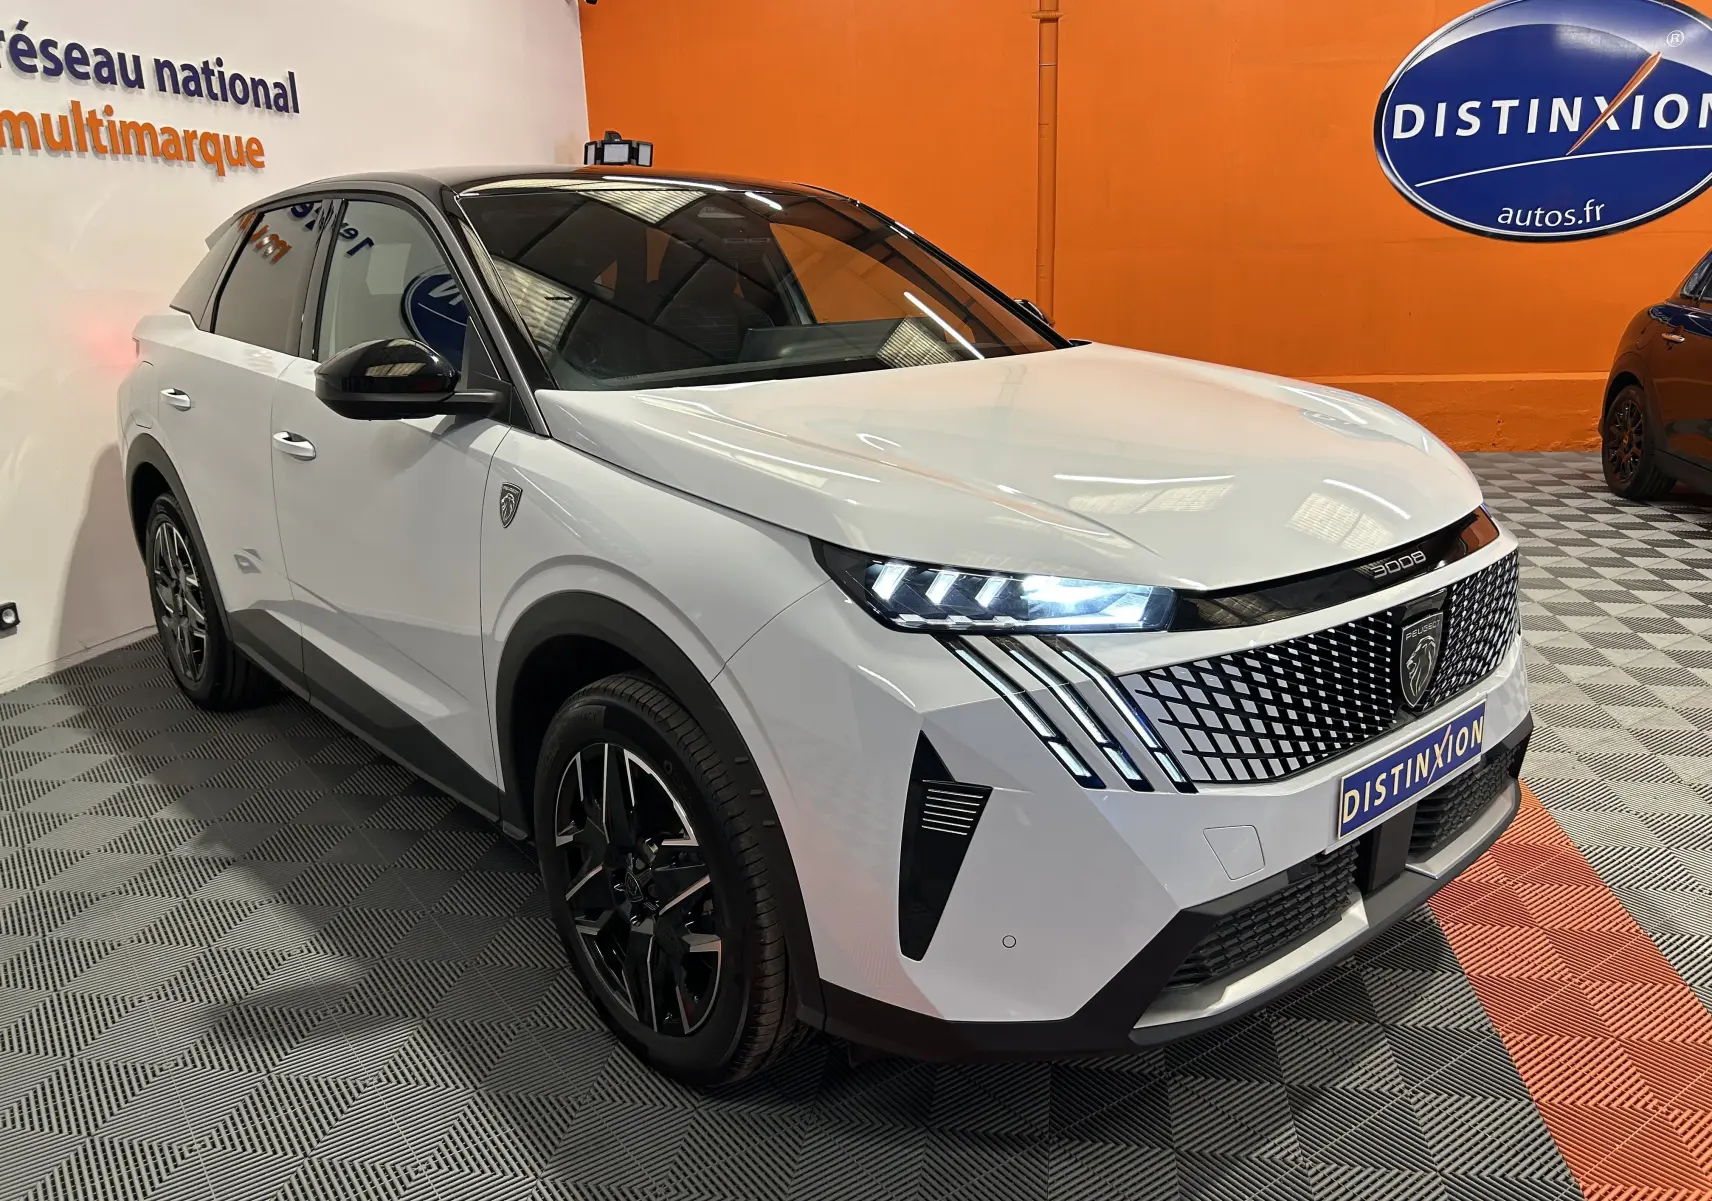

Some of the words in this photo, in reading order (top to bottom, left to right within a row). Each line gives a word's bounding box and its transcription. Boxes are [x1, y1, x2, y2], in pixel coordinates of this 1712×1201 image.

[154, 57, 300, 114] national
[0, 100, 266, 177] multimarque
[1497, 199, 1605, 227] autos.fr
[1372, 550, 1427, 580] 3008
[1405, 618, 1441, 641] PEUGEOT
[1342, 715, 1484, 825] DISTINXION
